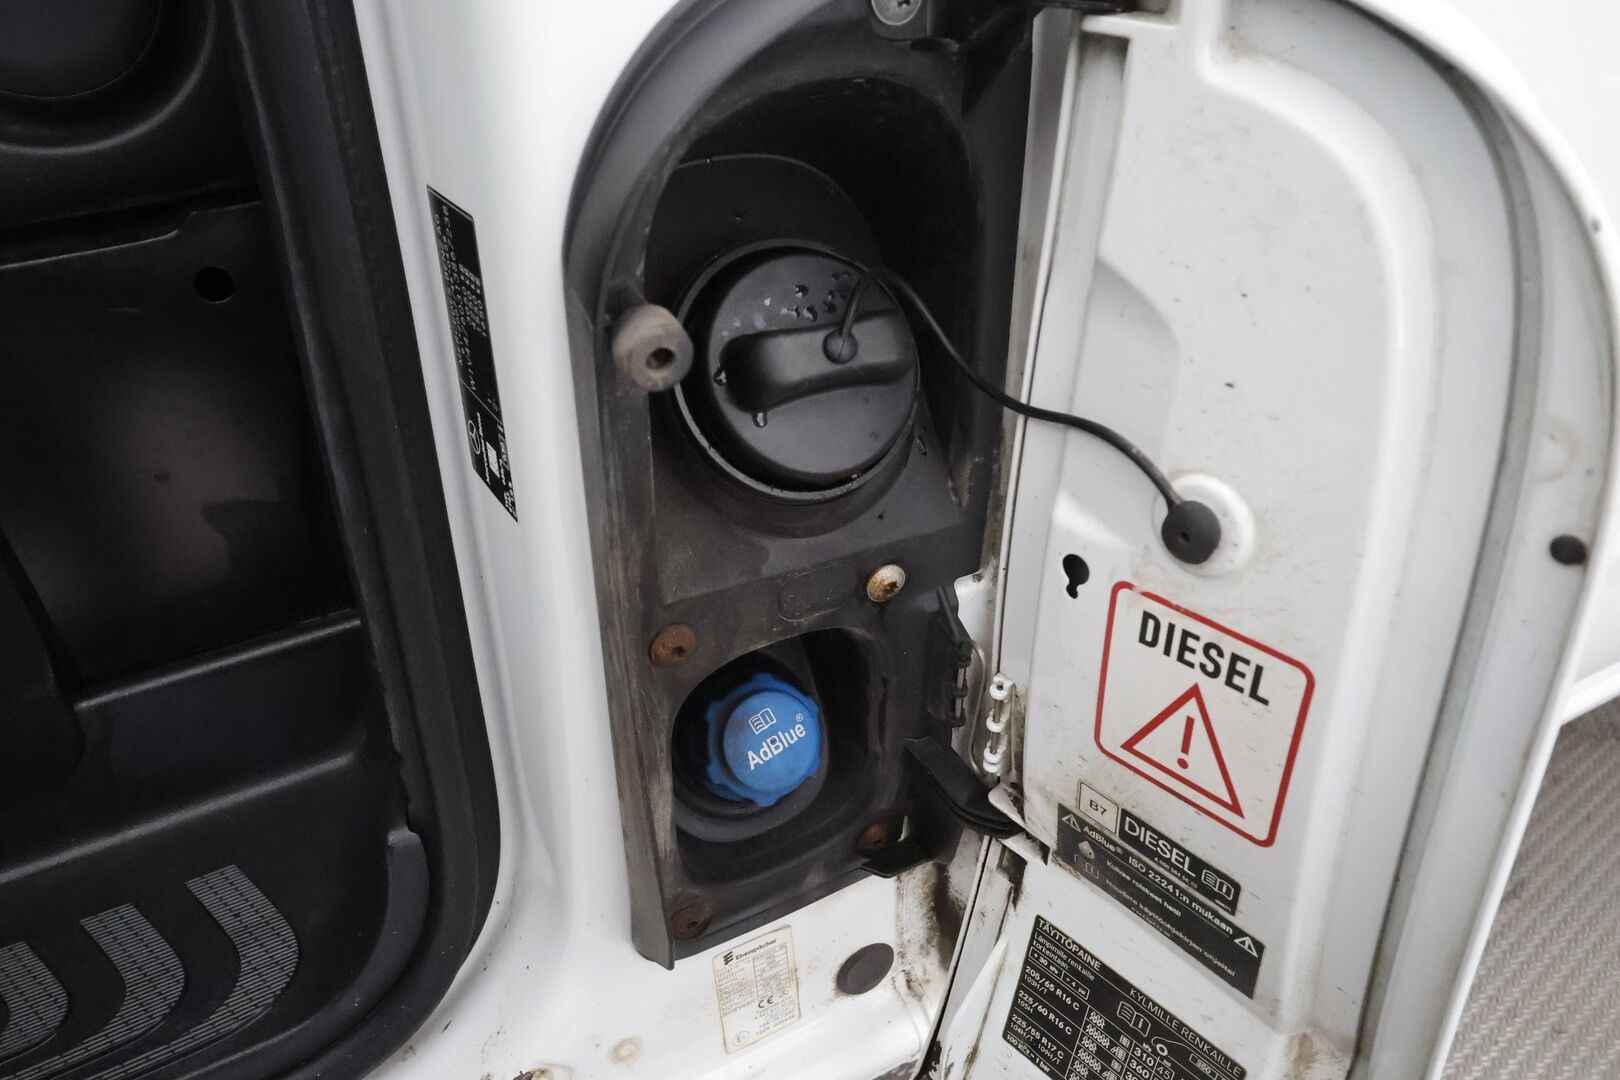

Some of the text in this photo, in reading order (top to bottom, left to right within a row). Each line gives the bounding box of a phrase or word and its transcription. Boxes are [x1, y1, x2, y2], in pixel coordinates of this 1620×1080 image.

[1137, 609, 1270, 707] DIESEL
[1088, 799, 1108, 816] B7
[1123, 816, 1197, 878] DIESEL
[1128, 856, 1146, 873] ISO
[1191, 901, 1234, 935] mukaan
[1034, 931, 1095, 981] Lämpimille renkaille
[1038, 918, 1101, 972] TÄYTTÖPAINE
[1025, 965, 1080, 1011] 205/65 R16 C
[1018, 989, 1073, 1035] 225/60 R16 C
[1129, 986, 1242, 1078] KYLMILLE RENKAILLE
[1006, 1034, 1018, 1044] 100
[1011, 1013, 1065, 1059] 225/55 R17 C
[1133, 1047, 1154, 1067] 310
[1129, 1059, 1150, 1079] 360
[1157, 1066, 1170, 1079] 45
